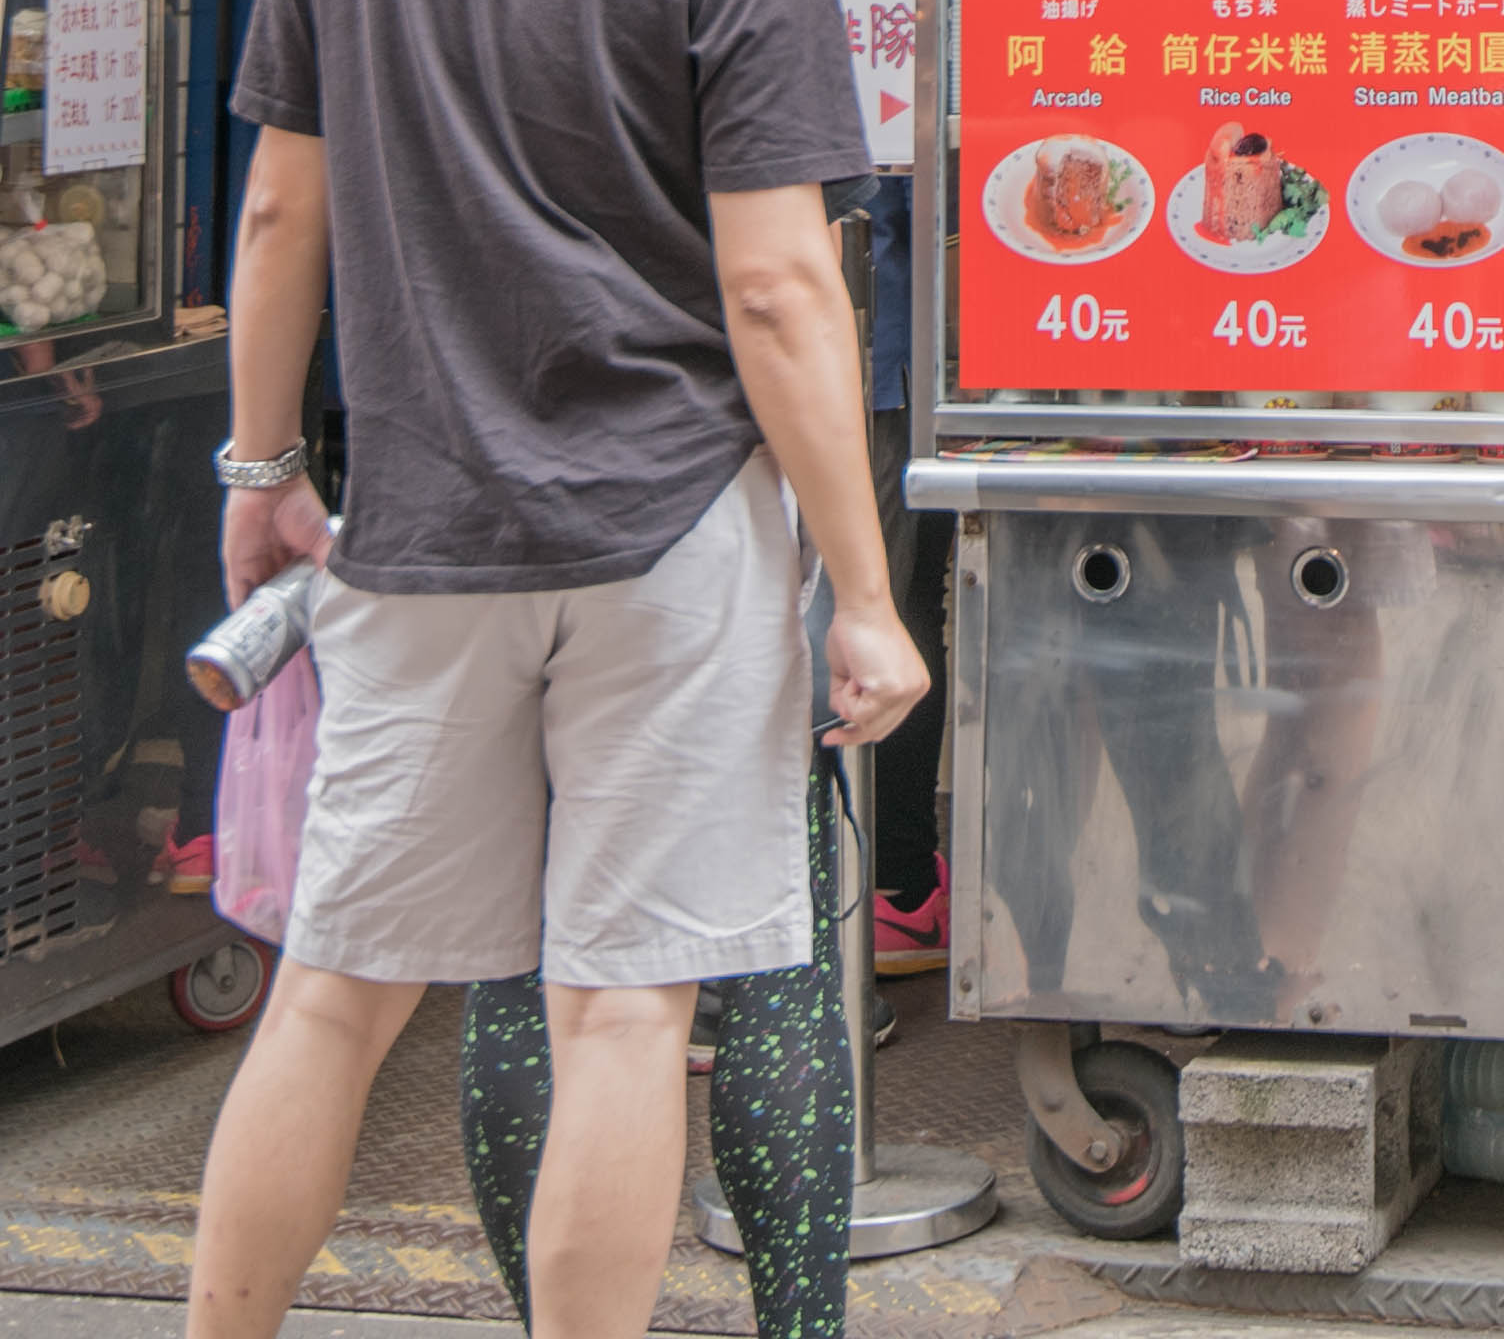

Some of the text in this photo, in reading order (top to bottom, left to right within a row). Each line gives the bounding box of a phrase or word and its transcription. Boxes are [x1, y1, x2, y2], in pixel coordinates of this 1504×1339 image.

[1007, 33, 1127, 77] 阿給
[1162, 32, 1328, 77] 筒仔米糕
[1032, 88, 1103, 108] Arcade
[1199, 87, 1293, 108] Rice Cake
[1353, 88, 1419, 108] Steam
[1037, 293, 1129, 342] 40元
[1213, 299, 1307, 348] 40元
[1409, 302, 1504, 351] 40元
